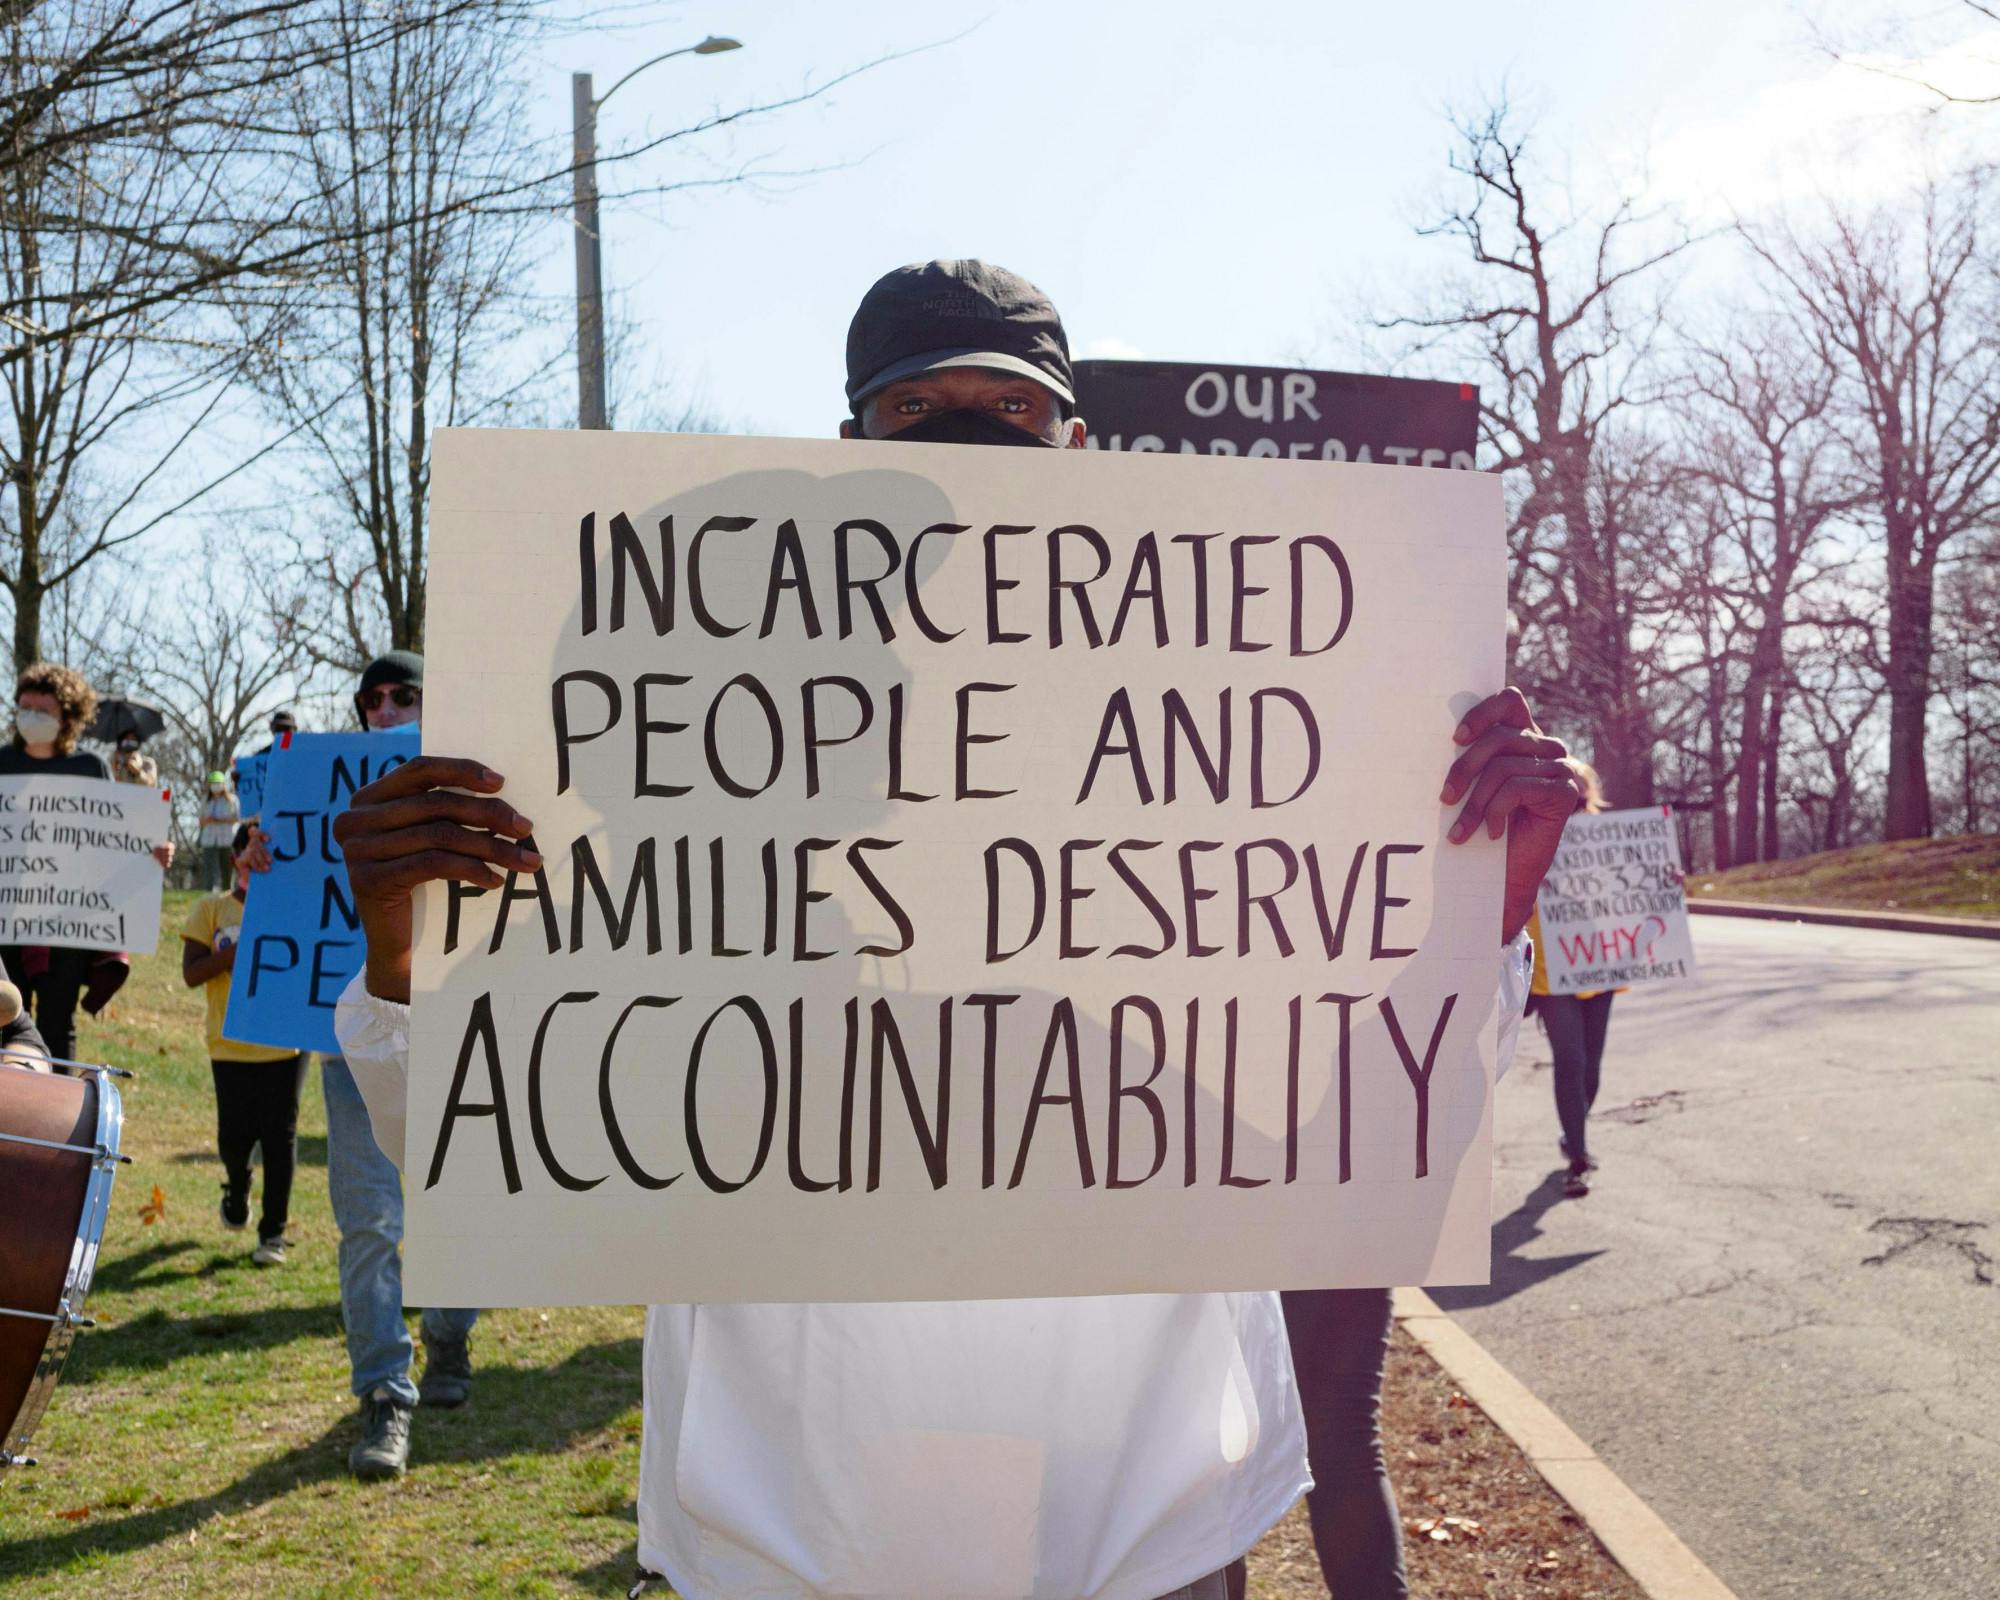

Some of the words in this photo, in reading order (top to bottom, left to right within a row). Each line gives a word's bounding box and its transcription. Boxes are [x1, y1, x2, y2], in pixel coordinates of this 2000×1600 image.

[1185, 371, 1322, 423] OUR
[580, 511, 1354, 657] INCARCERATED
[552, 670, 1018, 802] PEOPLE
[1075, 686, 1321, 808] AND
[329, 754, 407, 805] N
[28, 793, 125, 820] nuestros
[20, 819, 47, 843] de
[53, 823, 153, 854] impuestos
[984, 837, 1425, 964] DESERVE
[1593, 897, 1610, 918] IN
[13, 913, 126, 946] prisiones!
[1558, 915, 1667, 966] WHY?
[247, 934, 356, 1009] PE
[425, 991, 1458, 1194] ACCOUNTABILITY
